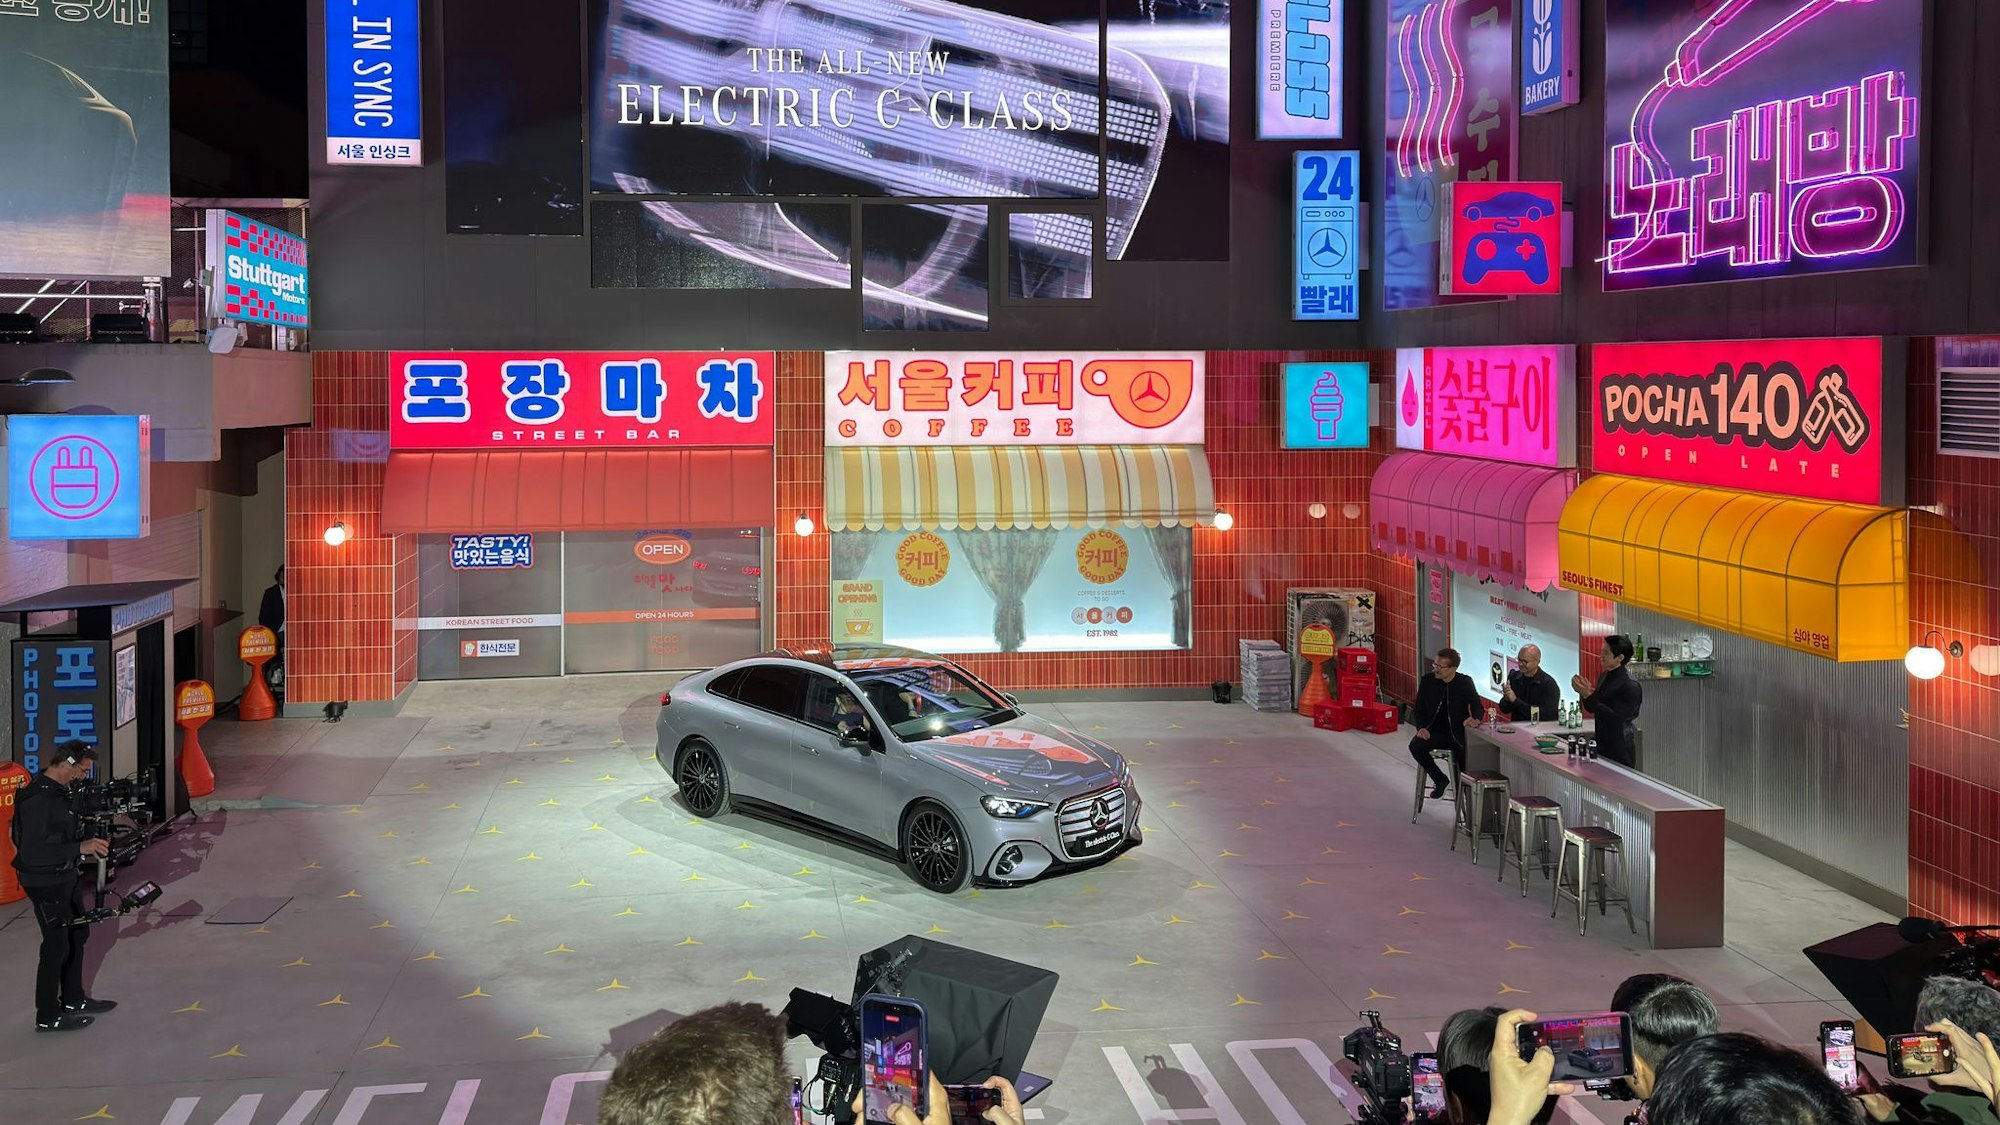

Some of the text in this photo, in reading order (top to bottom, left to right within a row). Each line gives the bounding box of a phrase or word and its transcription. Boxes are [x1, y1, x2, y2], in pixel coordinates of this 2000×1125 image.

[746, 47, 951, 76] THE ALL-NEW
[1270, 10, 1281, 92] PREMIERE
[1285, 0, 1331, 120] LASS
[352, 16, 393, 127] IN SYNC
[1525, 76, 1561, 106] BAKERY
[617, 83, 1074, 131] ELECTRIC C-CLASS
[336, 144, 411, 160] 서울 인싱크
[1302, 156, 1354, 201] 24
[1608, 71, 1917, 274] 노래방
[228, 254, 306, 296] Stuttgart
[281, 291, 306, 305] Motors
[1300, 285, 1354, 314] 빨래
[401, 358, 764, 425] 포장마차
[1424, 366, 1432, 430] GRILL
[1438, 355, 1551, 450] 숯불구이
[1605, 372, 1801, 440] POCHA 140
[492, 430, 681, 441] STREET BAR
[838, 418, 1074, 438] COFFEE
[1618, 444, 1840, 479] OPEN LATE
[454, 536, 530, 549] TASTY!
[642, 544, 684, 556] OPEN
[898, 532, 948, 560] GOOD COFFEE
[1077, 530, 1127, 558] GOOD COFFEE
[454, 548, 530, 566] 맛있는음식
[905, 551, 939, 570] 커피
[1084, 548, 1118, 568] 커피
[900, 568, 945, 585] GOOD DAY
[1079, 565, 1124, 582] GOOD DAY
[1562, 570, 1594, 589] SEOUL'S
[1594, 578, 1624, 596] FINEST
[445, 617, 534, 627] KOREAN STREET FOOD
[634, 610, 695, 620] OPEN 24 HOURS
[1086, 629, 1119, 637] EST. 1982
[1793, 628, 1830, 650] 심야 영업
[480, 643, 516, 654] 한식전문
